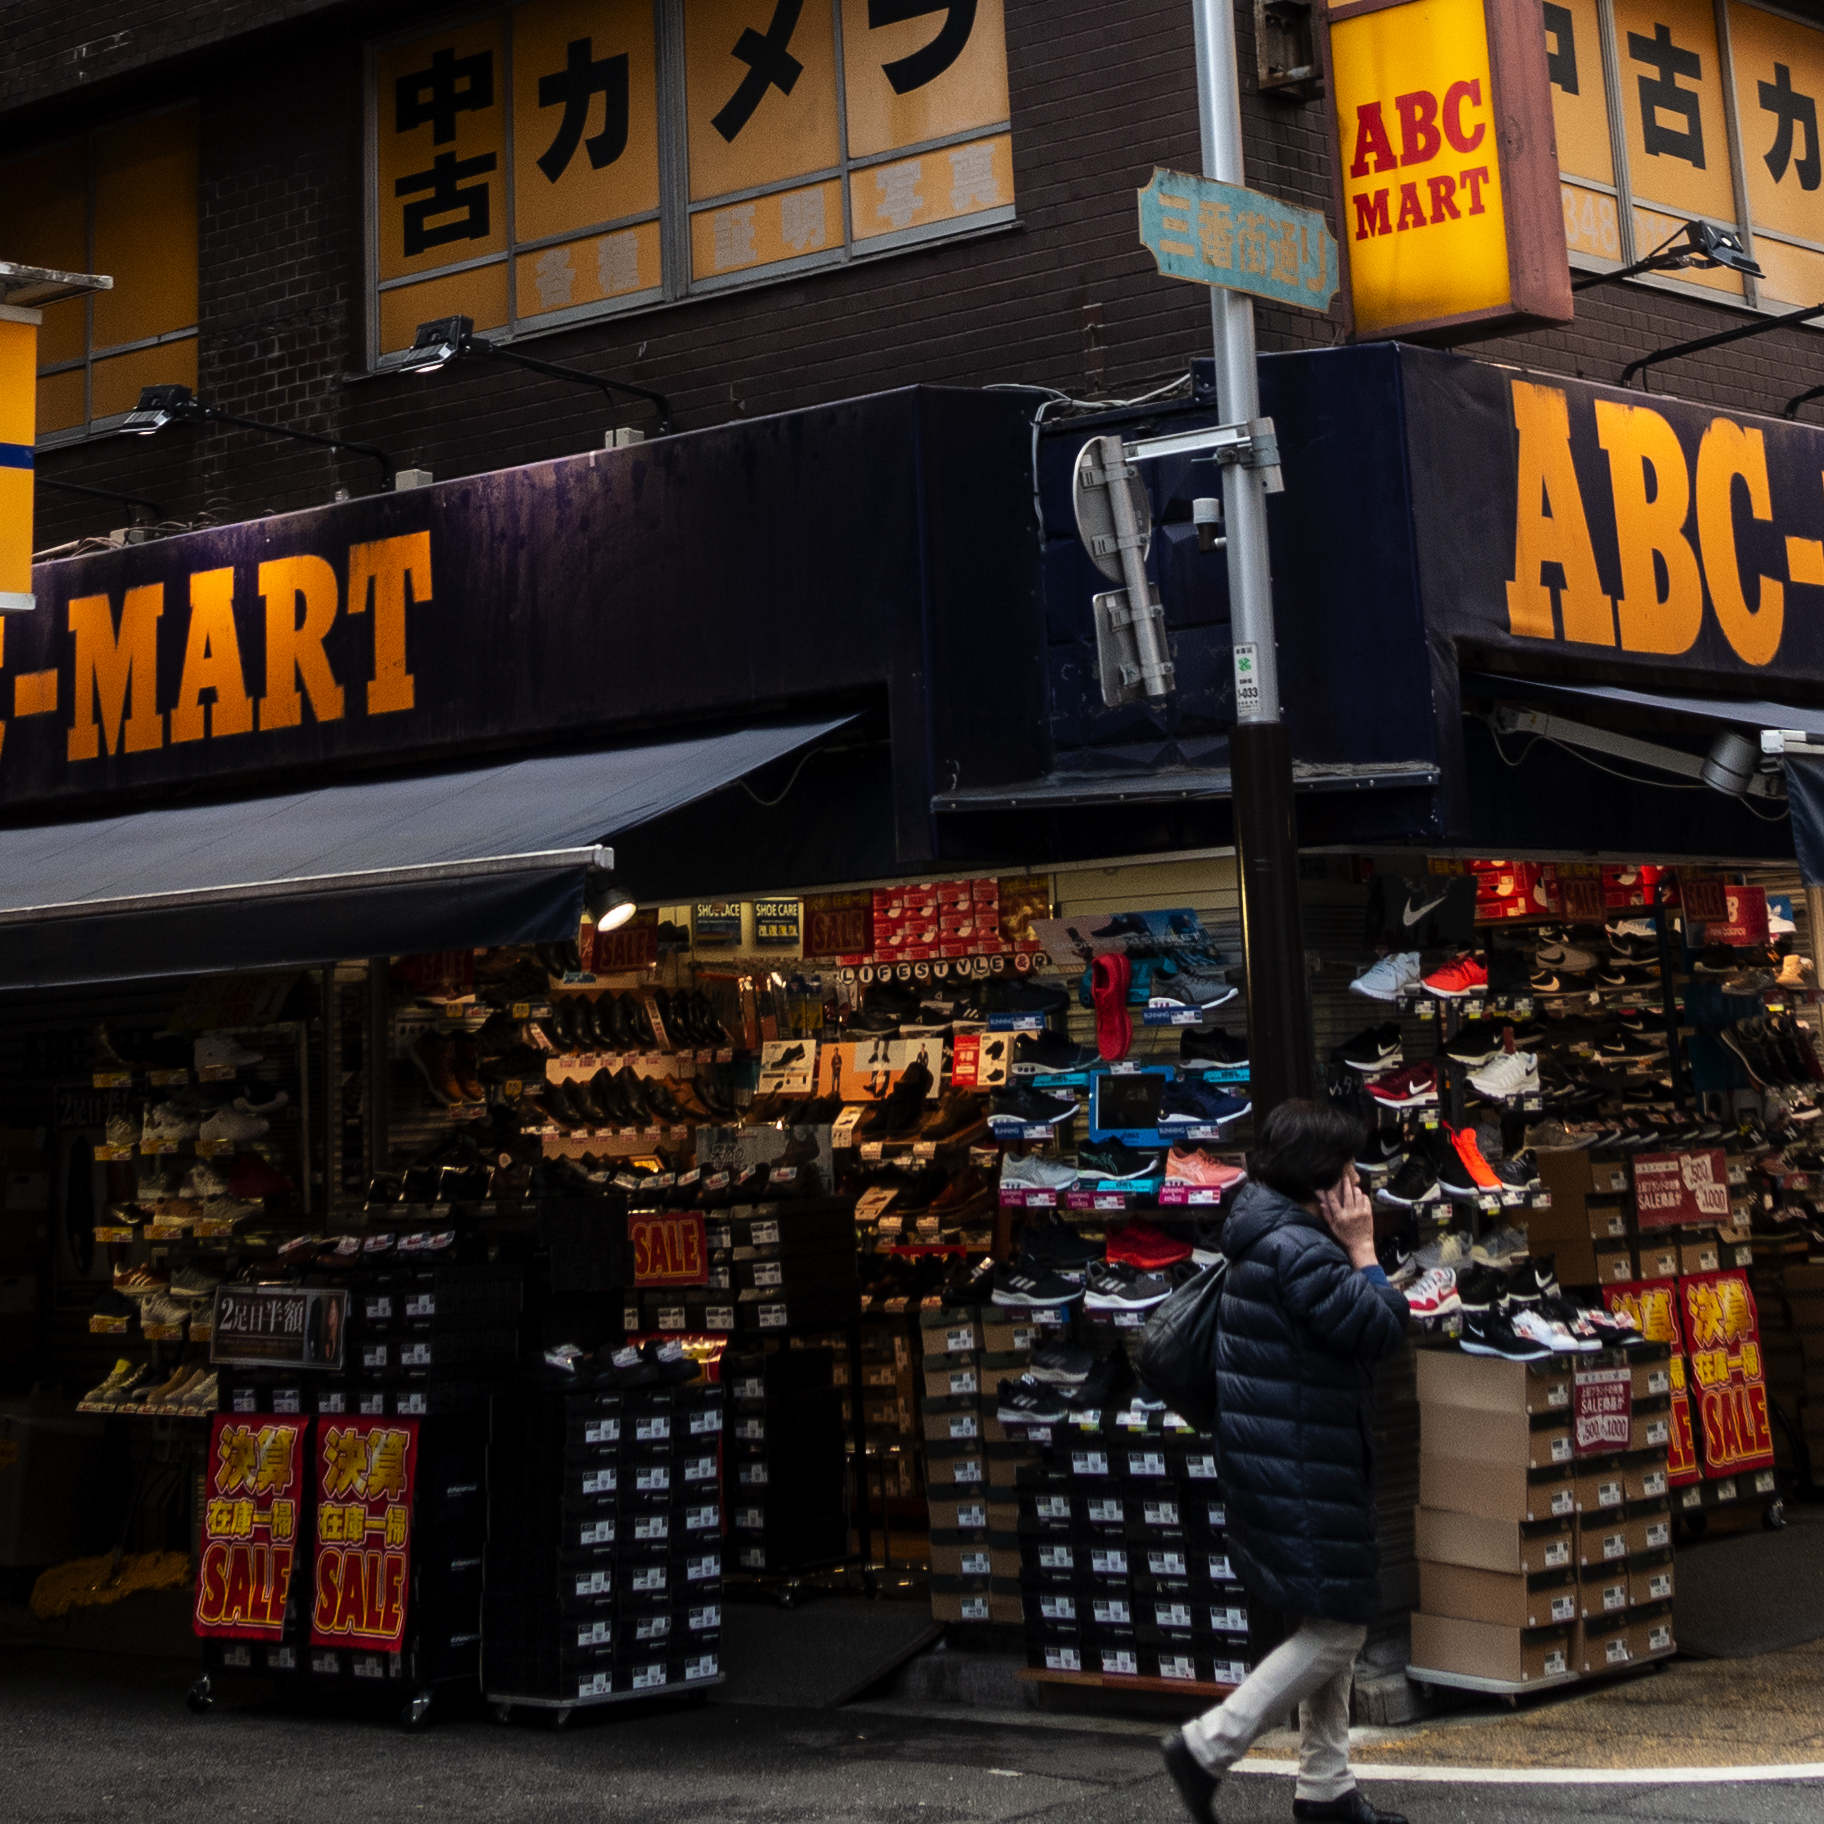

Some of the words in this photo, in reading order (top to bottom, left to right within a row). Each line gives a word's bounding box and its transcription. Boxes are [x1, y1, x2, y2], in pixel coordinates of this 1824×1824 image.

[1349, 76, 1486, 179] ABC
[1354, 164, 1490, 243] MART
[1156, 192, 1330, 292] 三番街通り
[755, 903, 778, 918] SHOE
[778, 903, 798, 918] CARE
[631, 1219, 703, 1279] SALE
[218, 1296, 305, 1335] 2足目半額
[1687, 1277, 1755, 1350] 決算
[215, 1422, 299, 1497] 決算
[322, 1425, 411, 1502] 決算
[1702, 1384, 1774, 1470] SALE
[207, 1496, 296, 1540] 在庫一掃
[318, 1502, 407, 1549] 在庫一掃
[198, 1541, 294, 1627] SALE
[314, 1547, 407, 1641] SALE
